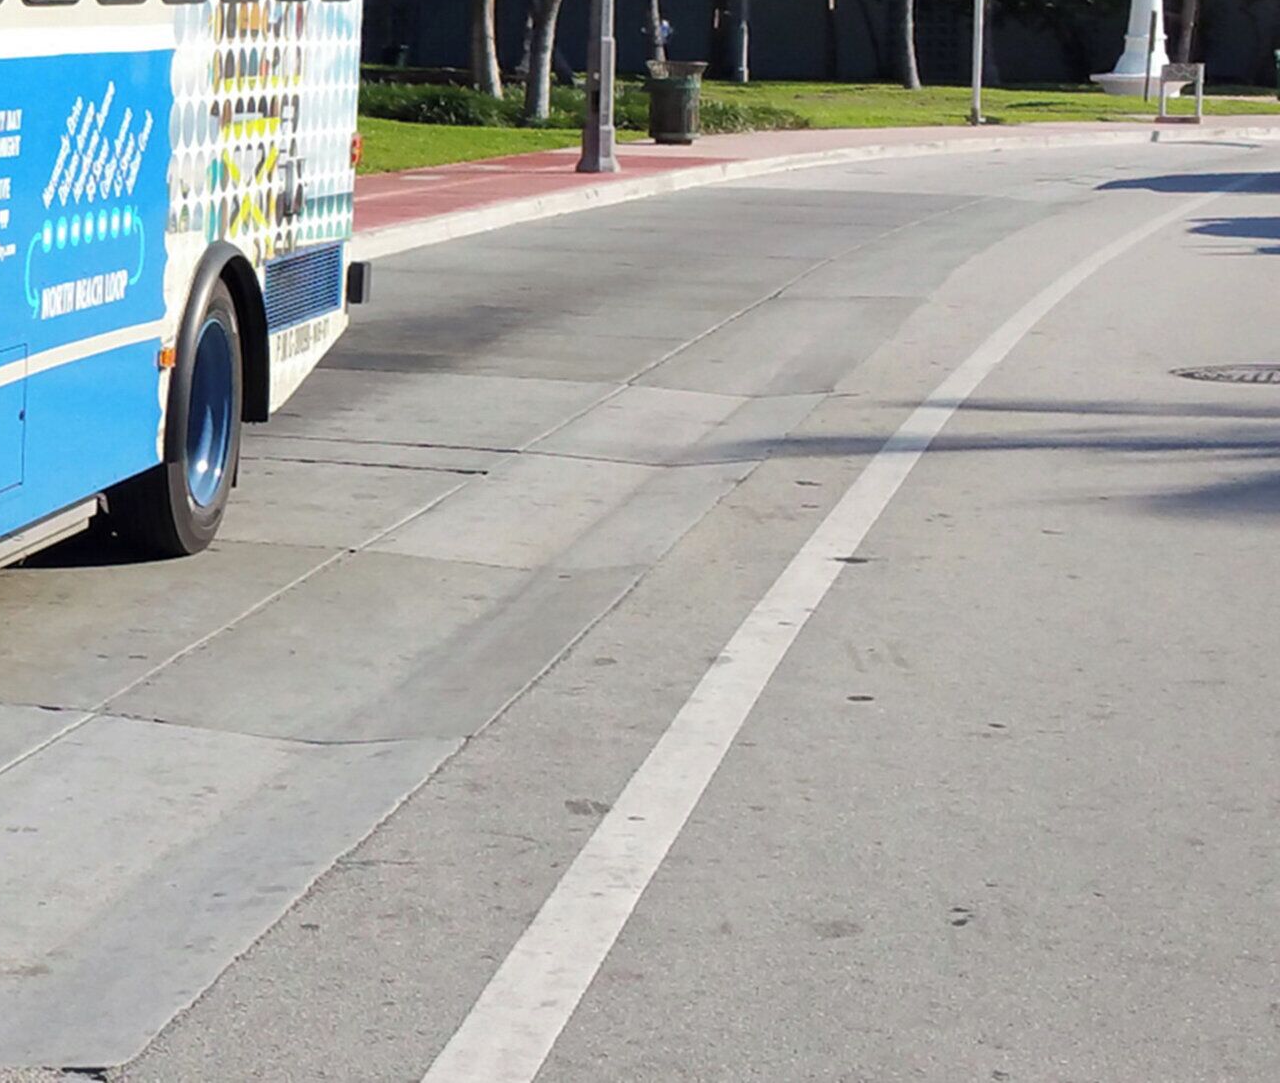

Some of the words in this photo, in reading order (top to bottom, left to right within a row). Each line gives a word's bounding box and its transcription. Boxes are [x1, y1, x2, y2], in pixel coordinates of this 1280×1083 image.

[41, 281, 75, 320] NORTH
[75, 274, 104, 312] BEACH
[104, 268, 128, 304] LOOP
